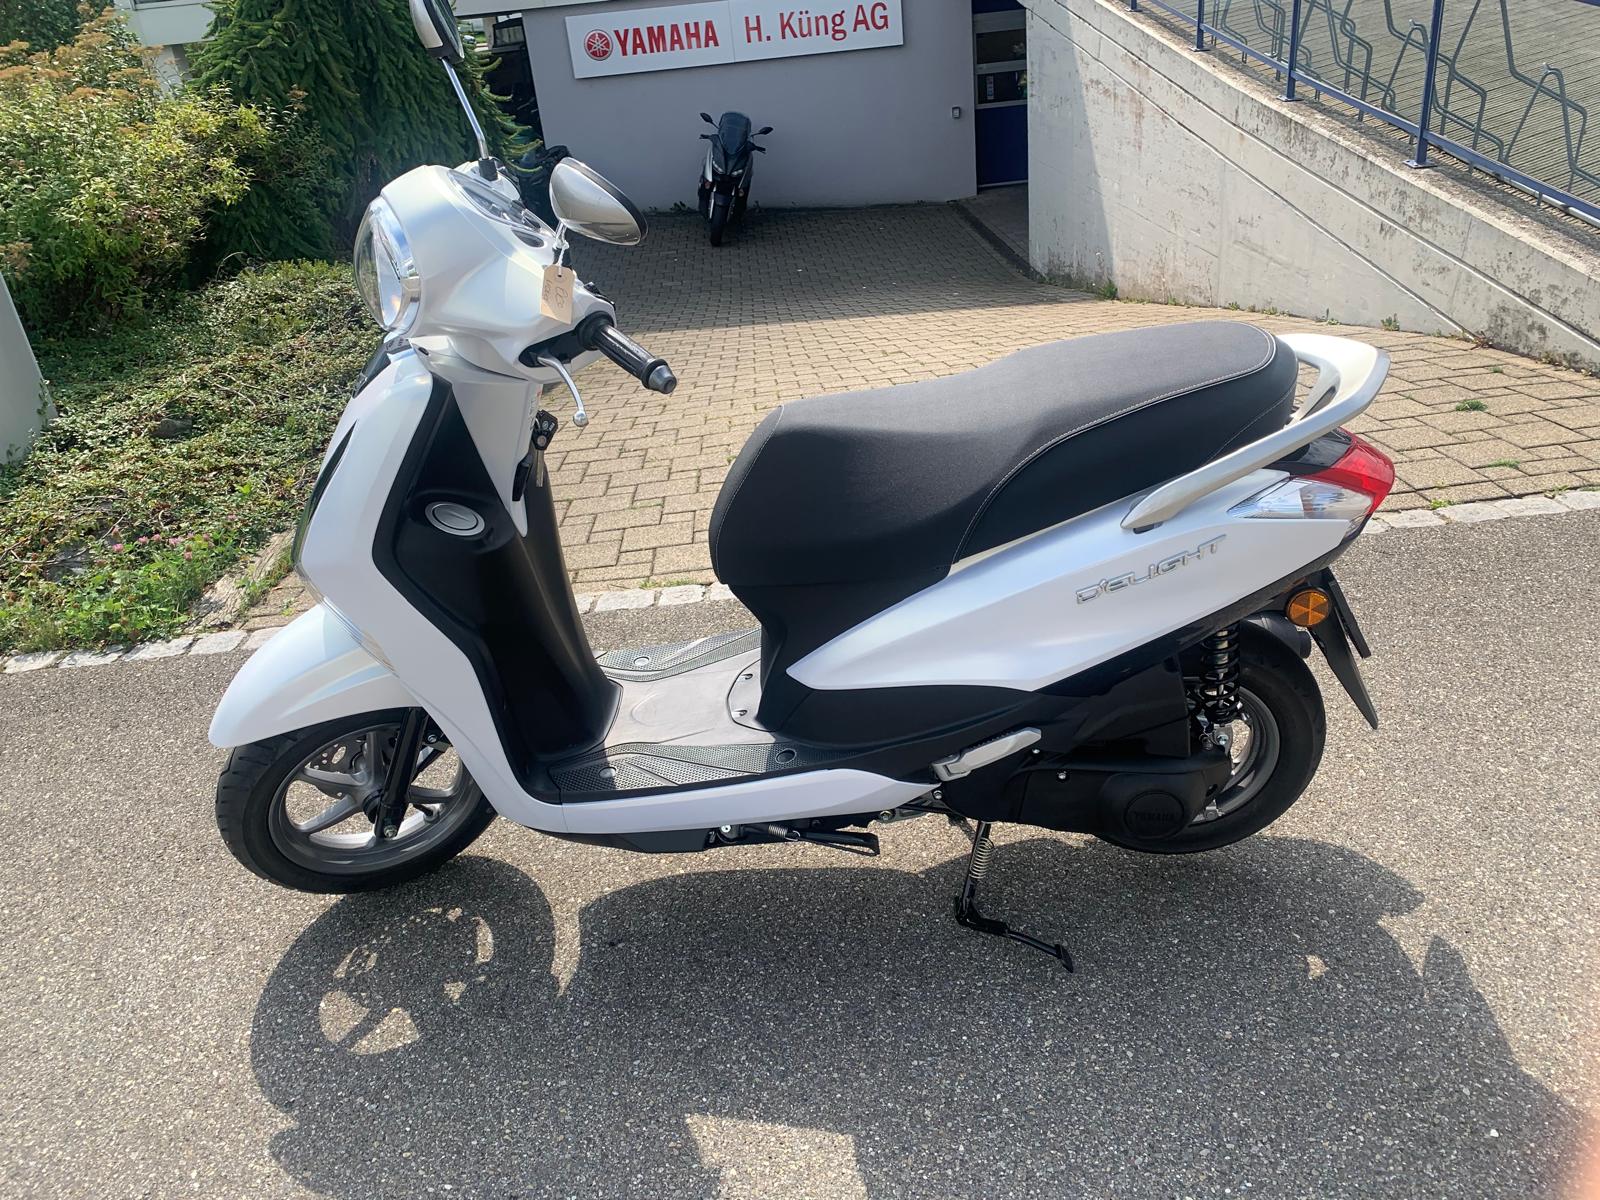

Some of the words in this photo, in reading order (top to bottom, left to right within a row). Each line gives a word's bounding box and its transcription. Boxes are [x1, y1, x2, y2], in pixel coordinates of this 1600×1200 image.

[613, 20, 720, 57] YAMAHA
[744, 15, 772, 43] H.
[779, 9, 848, 41] Küng
[852, 2, 889, 33] AG
